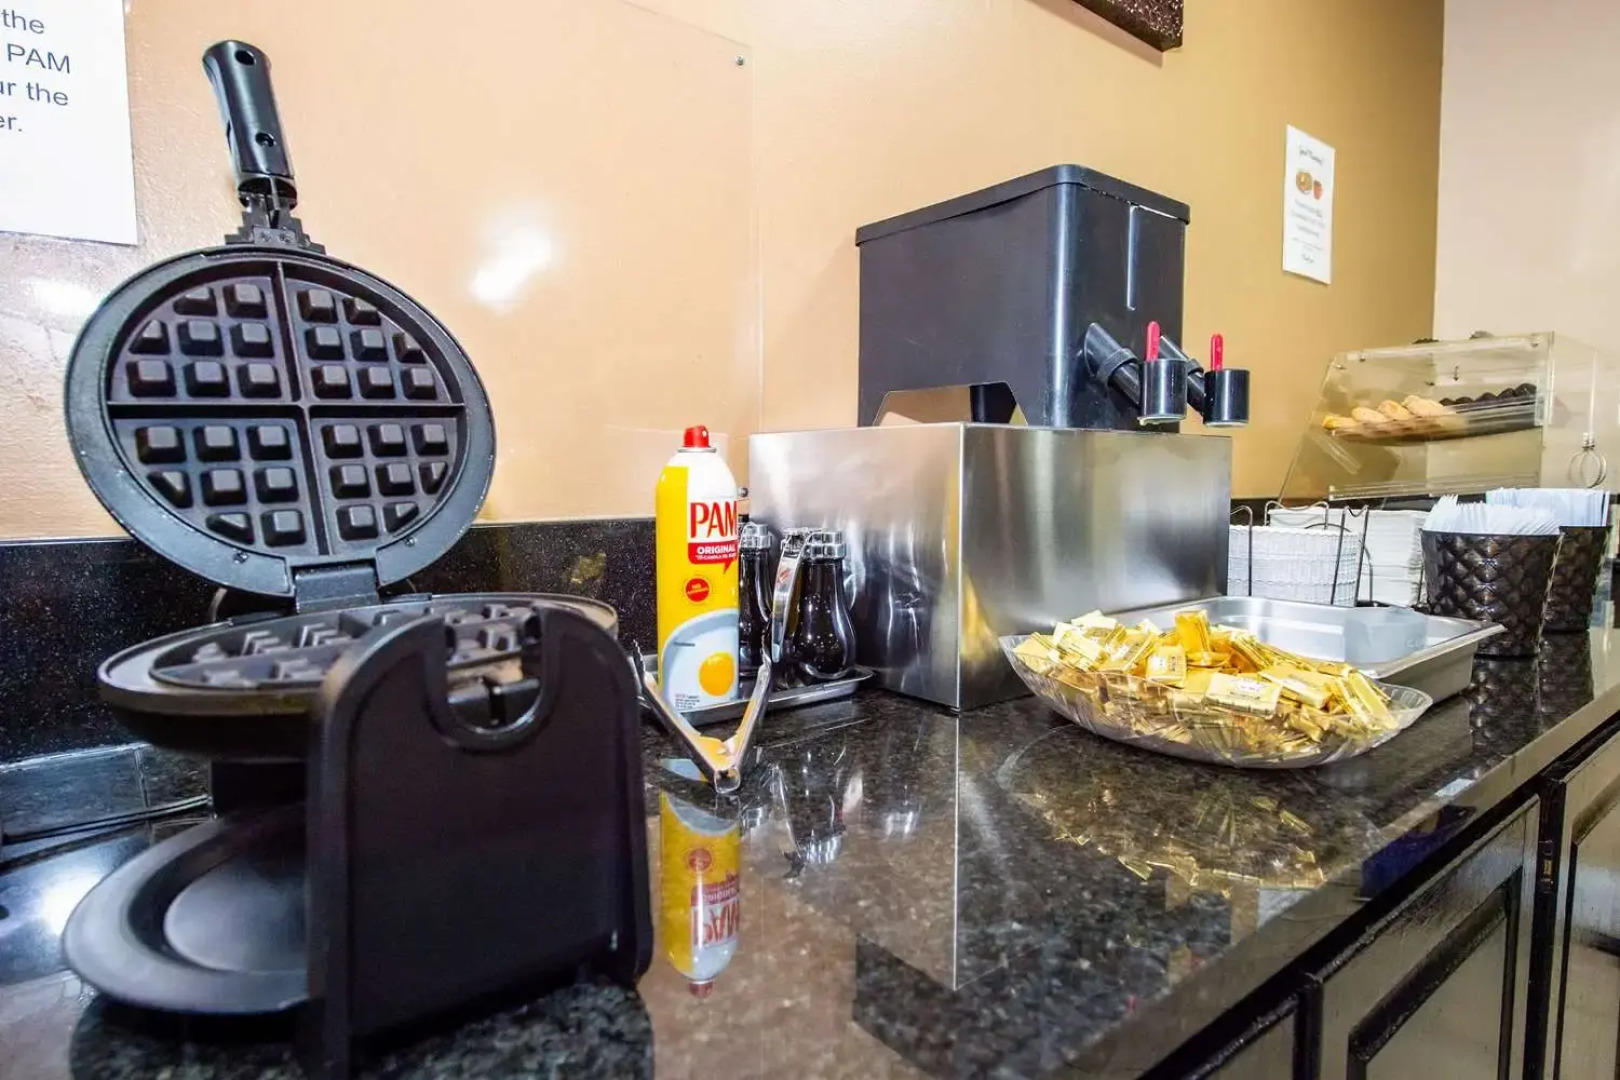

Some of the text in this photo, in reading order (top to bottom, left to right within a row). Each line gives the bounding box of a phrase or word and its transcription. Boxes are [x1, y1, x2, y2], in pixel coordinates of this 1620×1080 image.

[1, 9, 45, 34] the
[7, 43, 70, 74] PAM
[26, 82, 69, 106] the
[690, 501, 738, 538] PAM
[697, 544, 736, 555] ORIGINAL
